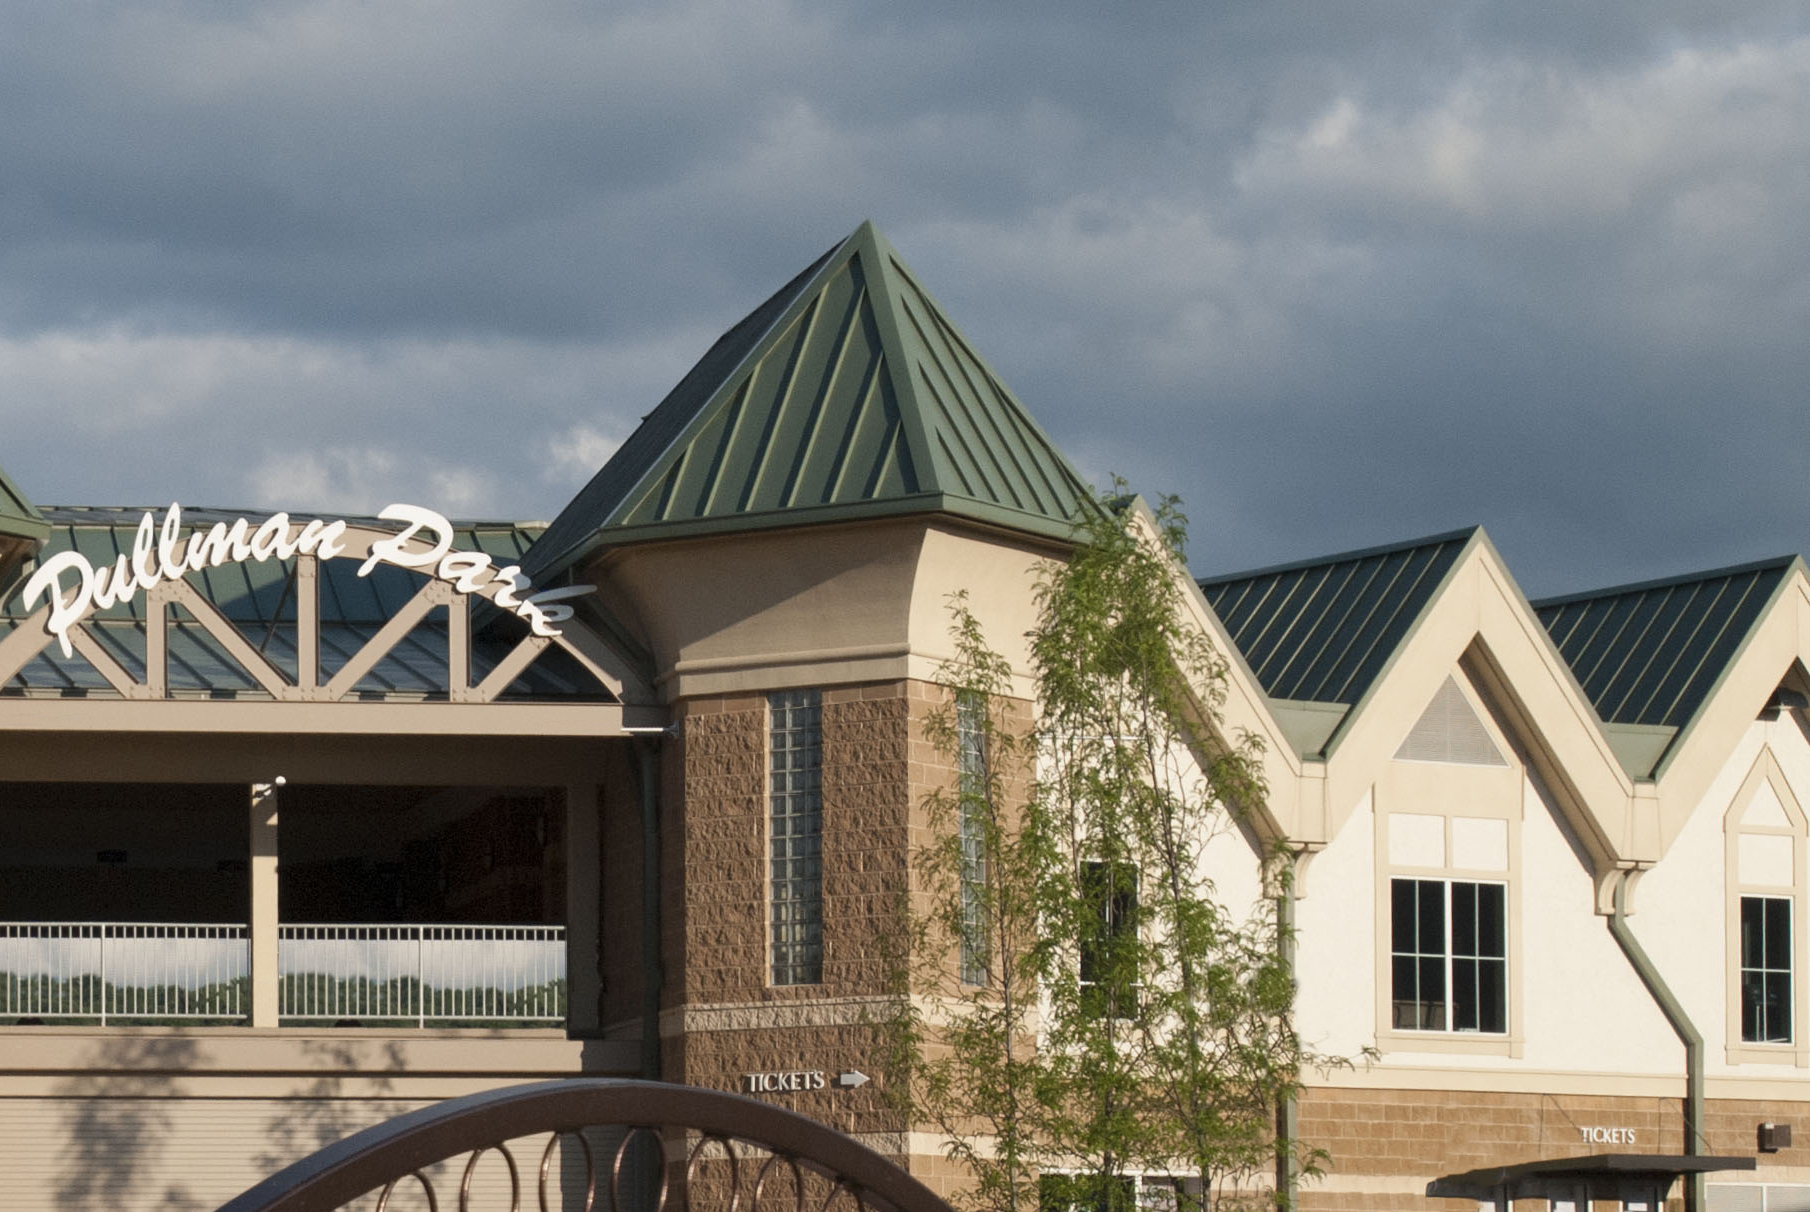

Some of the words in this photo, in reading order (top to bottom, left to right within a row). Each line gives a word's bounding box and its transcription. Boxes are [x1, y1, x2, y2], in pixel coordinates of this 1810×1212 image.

[23, 502, 346, 658] Pullman
[357, 503, 598, 637] Park
[746, 1070, 825, 1092] TICKETS
[1581, 1127, 1636, 1144] TICKETS
